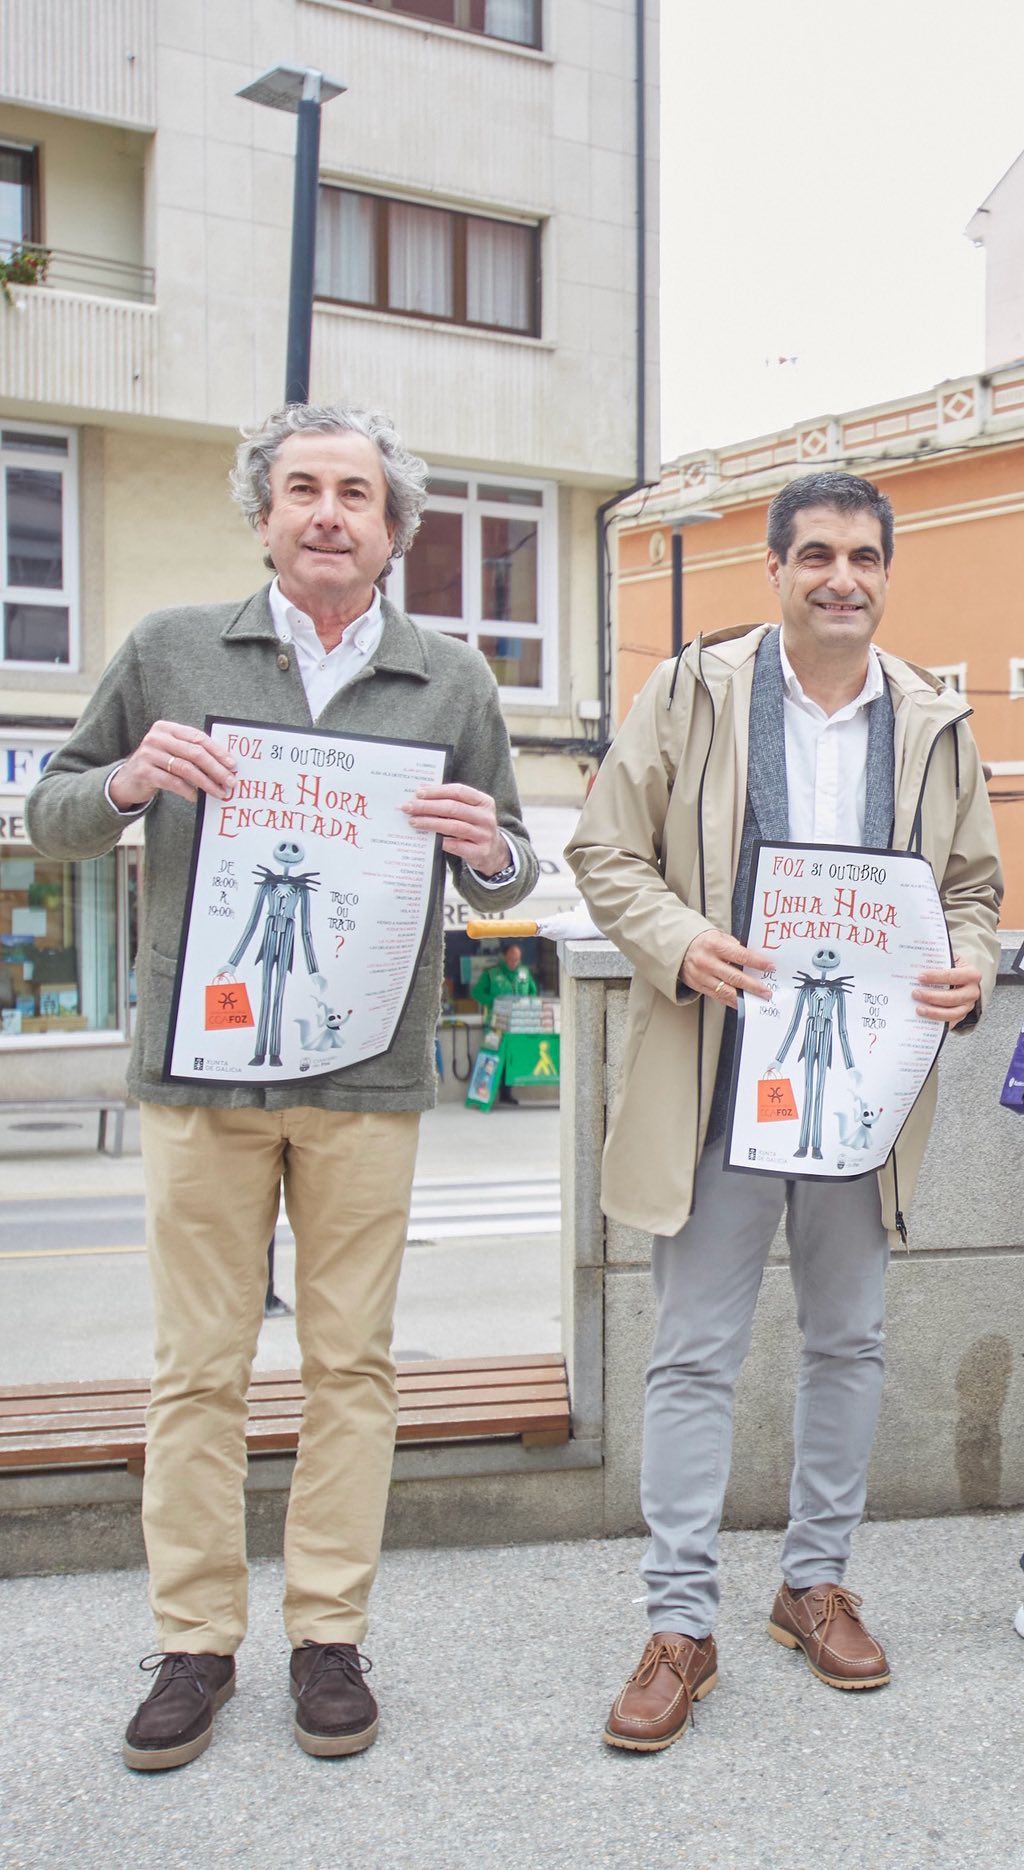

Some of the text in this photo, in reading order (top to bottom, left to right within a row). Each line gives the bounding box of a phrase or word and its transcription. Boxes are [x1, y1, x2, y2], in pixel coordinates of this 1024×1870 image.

[227, 733, 262, 760] FOZ
[270, 744, 283, 761] 31
[290, 746, 355, 772] OUTUBRO
[7, 750, 55, 783] F
[295, 773, 373, 820] HORA
[217, 805, 364, 849] ENCANTADA
[218, 859, 235, 876] DE
[773, 856, 887, 885] FOZ 31 OUTUBRO
[329, 891, 359, 906] TRUCO
[762, 888, 828, 918] UNHA
[833, 887, 901, 928] HORA
[336, 906, 348, 918] OU
[328, 917, 356, 931] TRATO
[335, 934, 345, 959] ?
[761, 920, 893, 954] ENCANTADA
[862, 992, 889, 1005] TRUCO
[861, 1016, 887, 1029] TRATO
[869, 1006, 880, 1017] OU
[868, 1033, 878, 1054] ?
